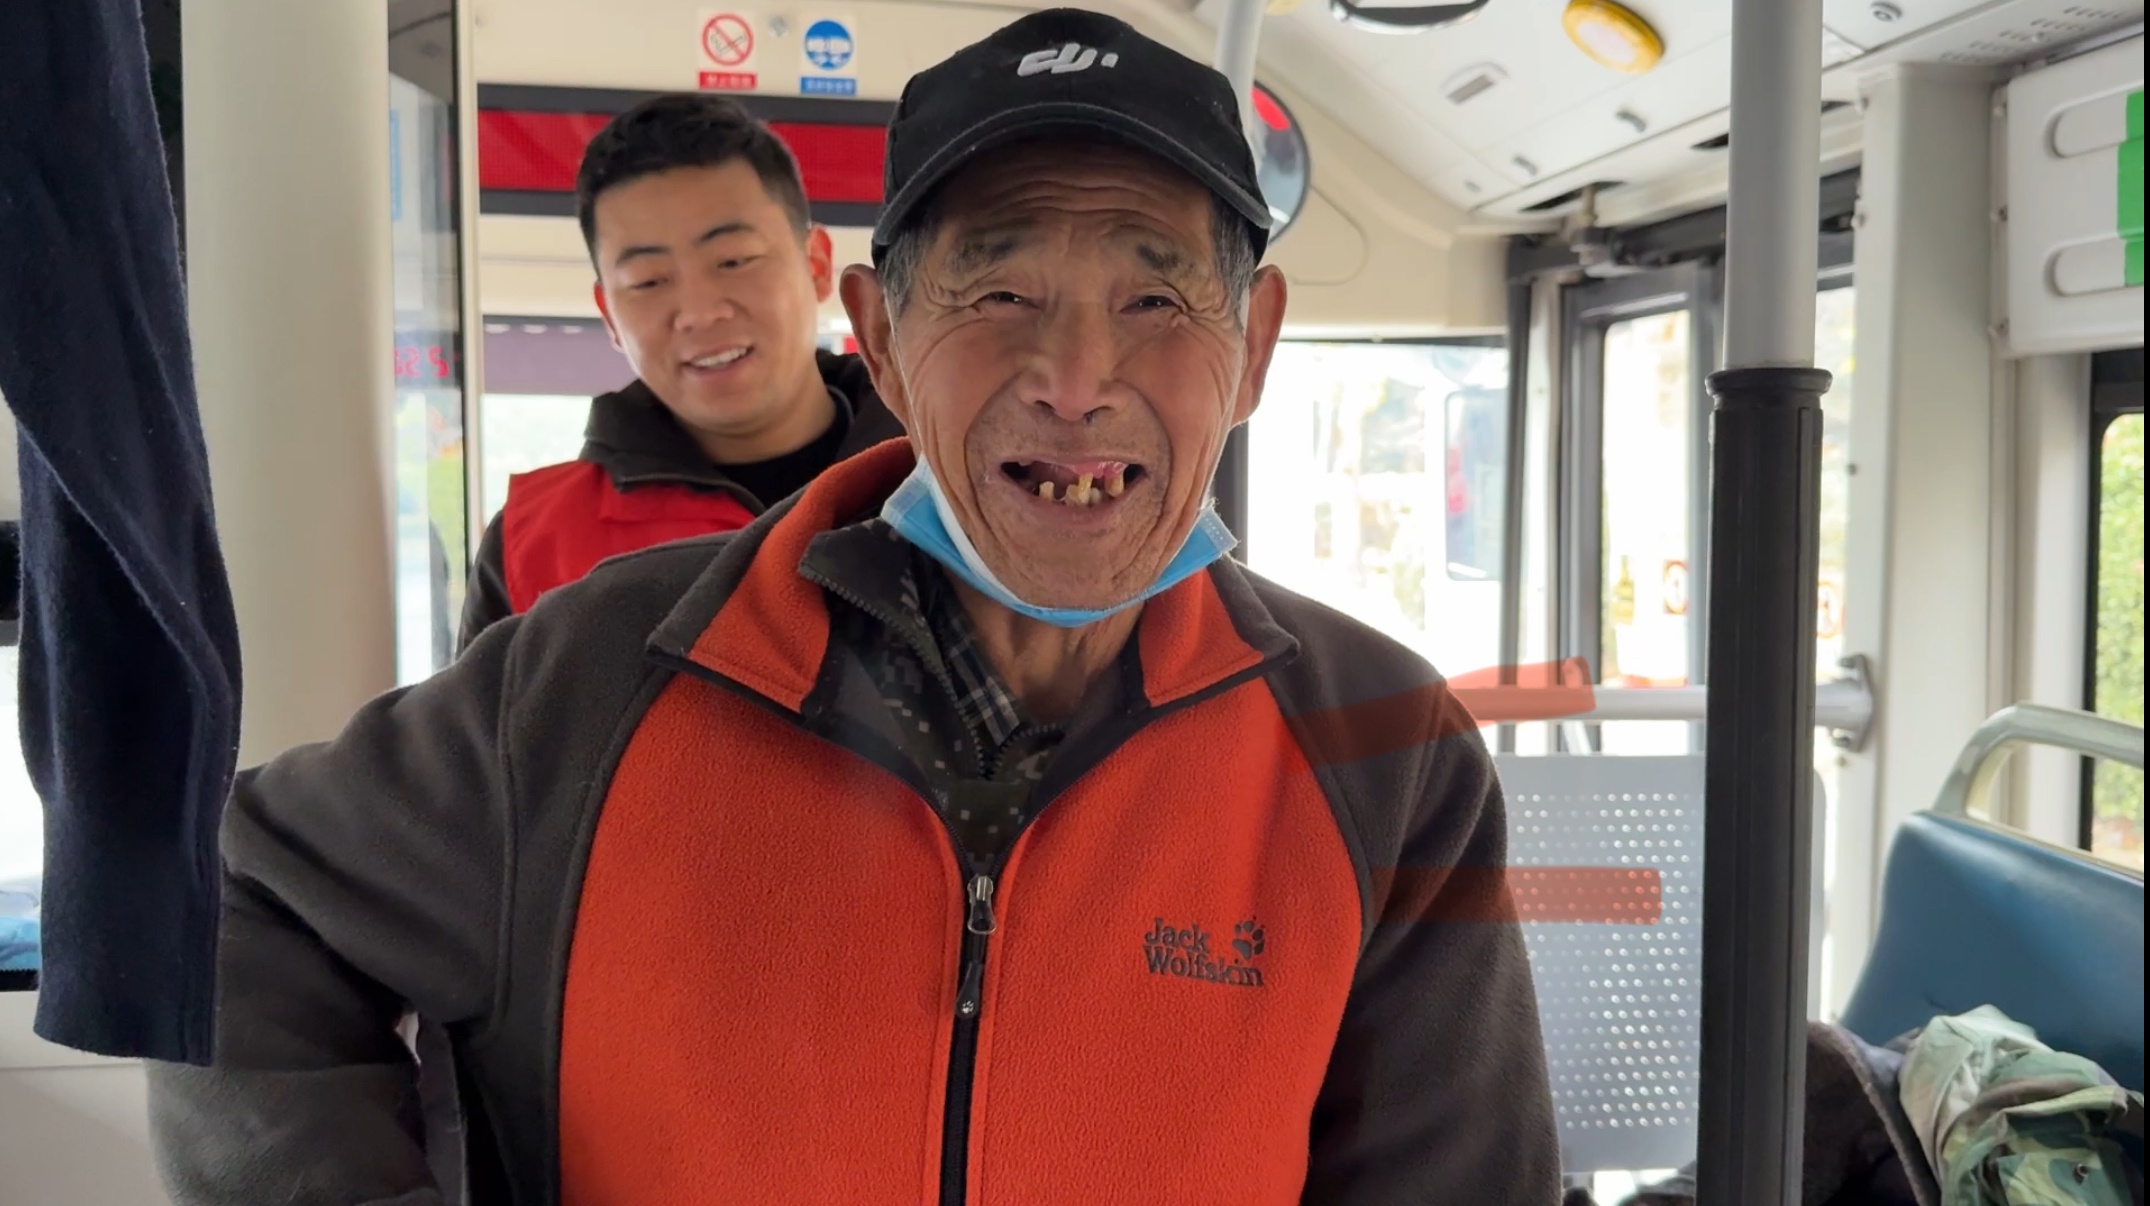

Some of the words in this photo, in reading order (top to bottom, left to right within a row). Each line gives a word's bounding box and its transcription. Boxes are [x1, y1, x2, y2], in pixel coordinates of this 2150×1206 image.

[1017, 43, 1119, 77] DJI
[1144, 917, 1210, 954] Jack
[1143, 945, 1265, 987] Wolfskin
